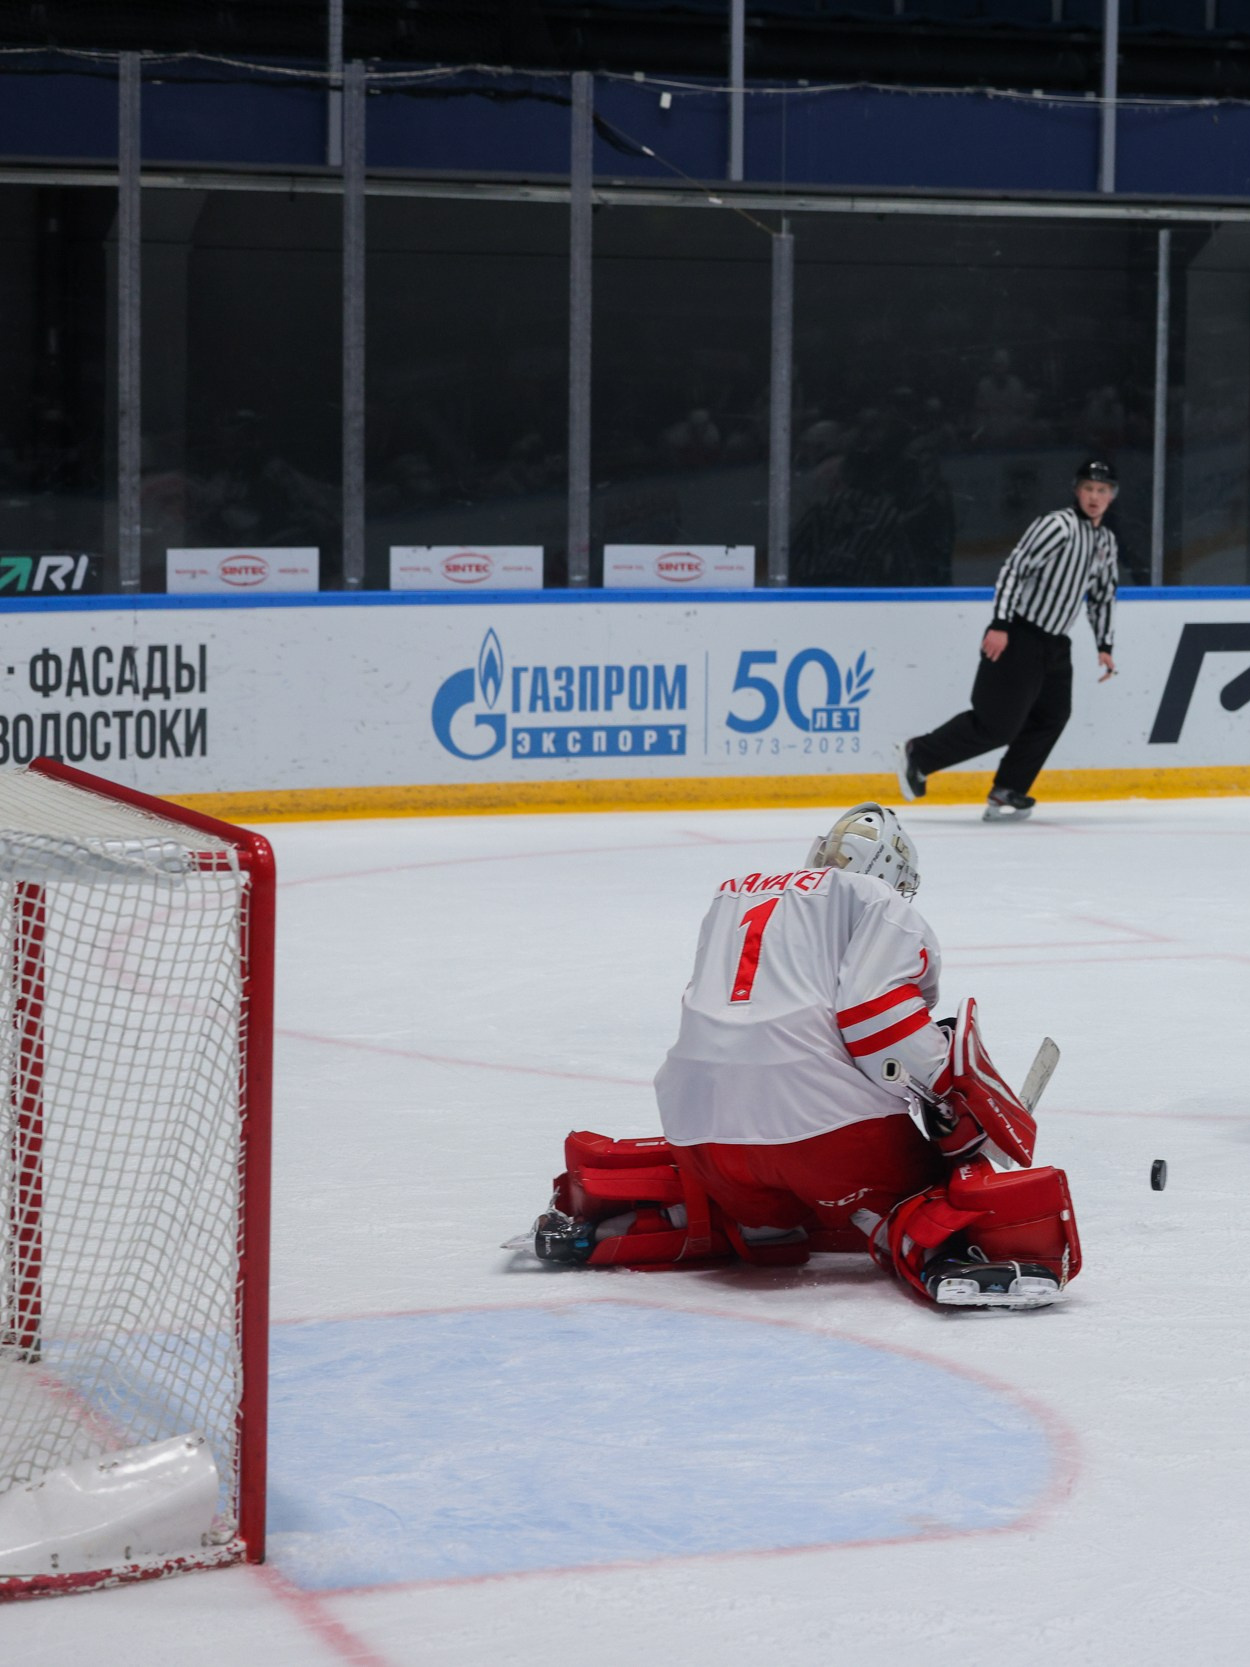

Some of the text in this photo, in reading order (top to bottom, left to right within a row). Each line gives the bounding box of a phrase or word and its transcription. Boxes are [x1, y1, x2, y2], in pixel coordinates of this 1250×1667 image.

[221, 565, 266, 576] SINTEC
[445, 563, 490, 574] SINTEC
[658, 562, 702, 573] SINTEC
[29, 644, 207, 701] ФАСАДЫ
[512, 664, 687, 713] ГАЗПРОМ
[725, 647, 842, 734] 50
[814, 711, 857, 729] ЛЕТ
[516, 729, 682, 754] ЭКСПОРТ
[730, 897, 780, 1002] 1
